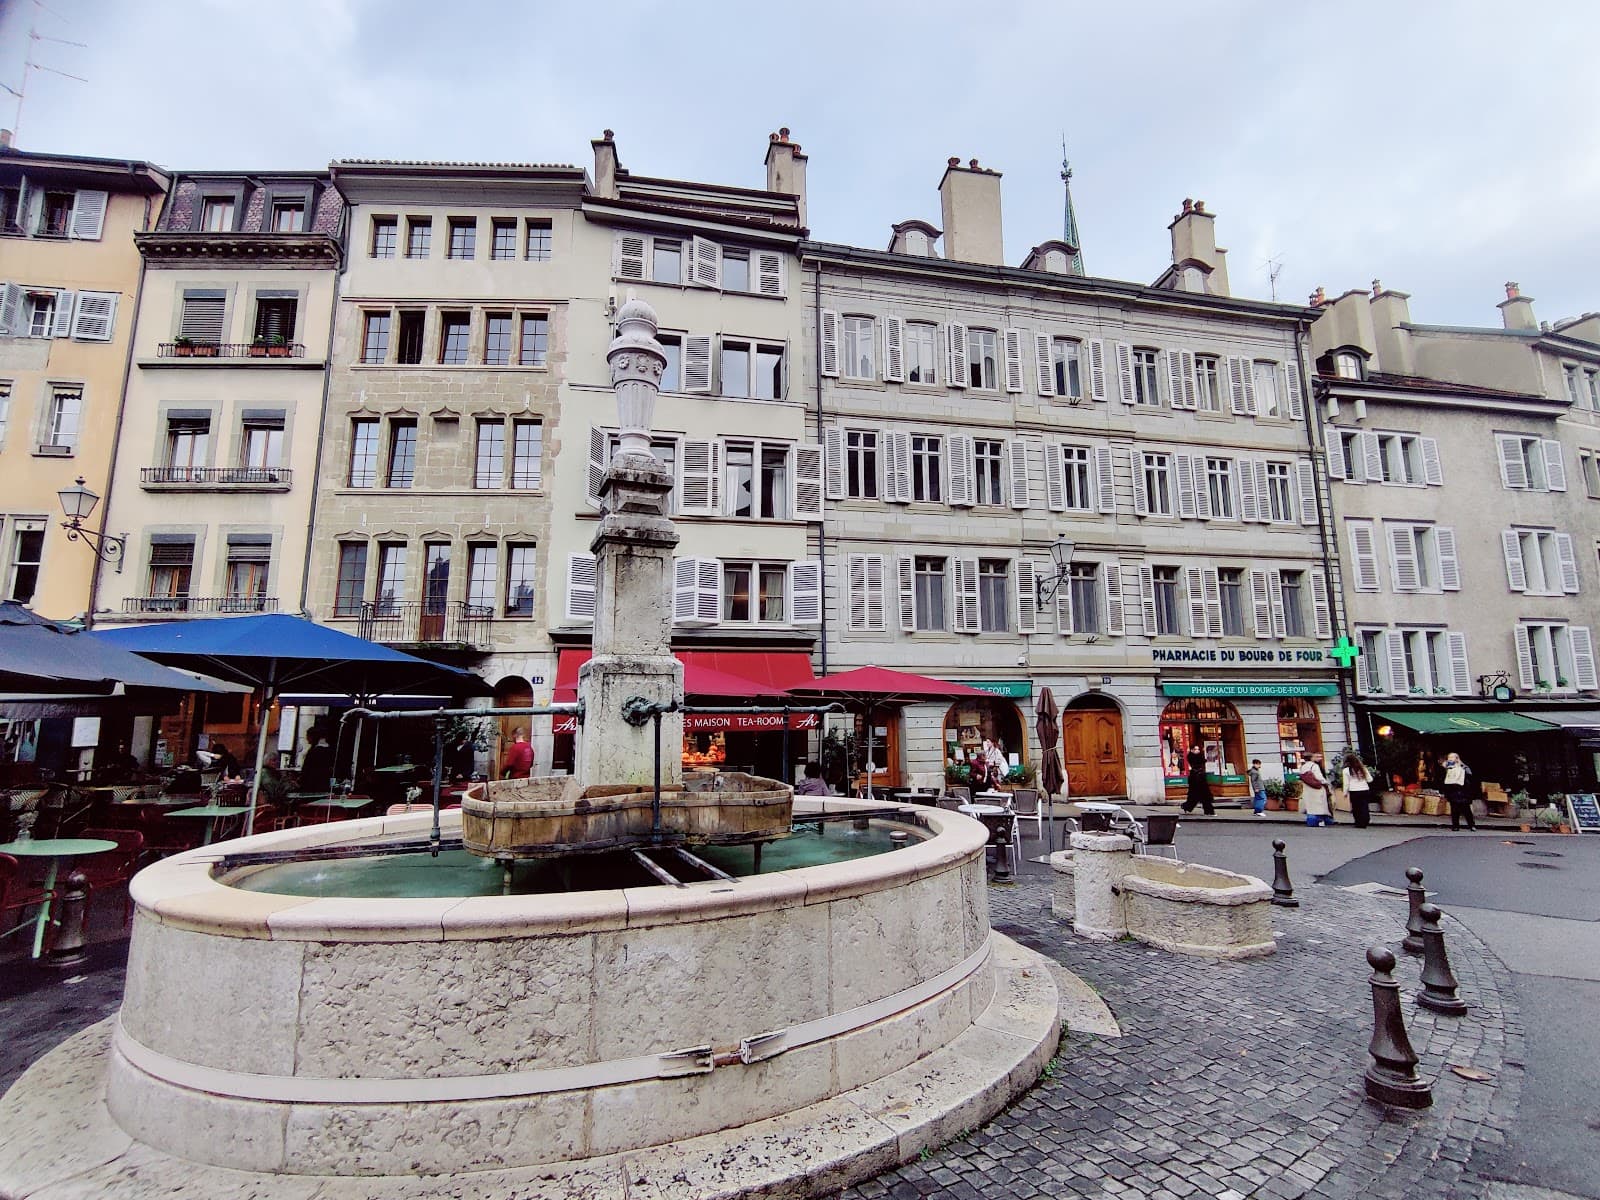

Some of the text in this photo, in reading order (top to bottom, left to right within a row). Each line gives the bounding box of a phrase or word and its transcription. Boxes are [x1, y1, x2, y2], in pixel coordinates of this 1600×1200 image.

[1152, 649, 1323, 662] PHARMACIE DU BOURG DE FOUR
[1191, 686, 1310, 695] PHARMACIE DU BOURG-DE-FOUR
[682, 716, 784, 728] ES MAISON TEA-ROOM
